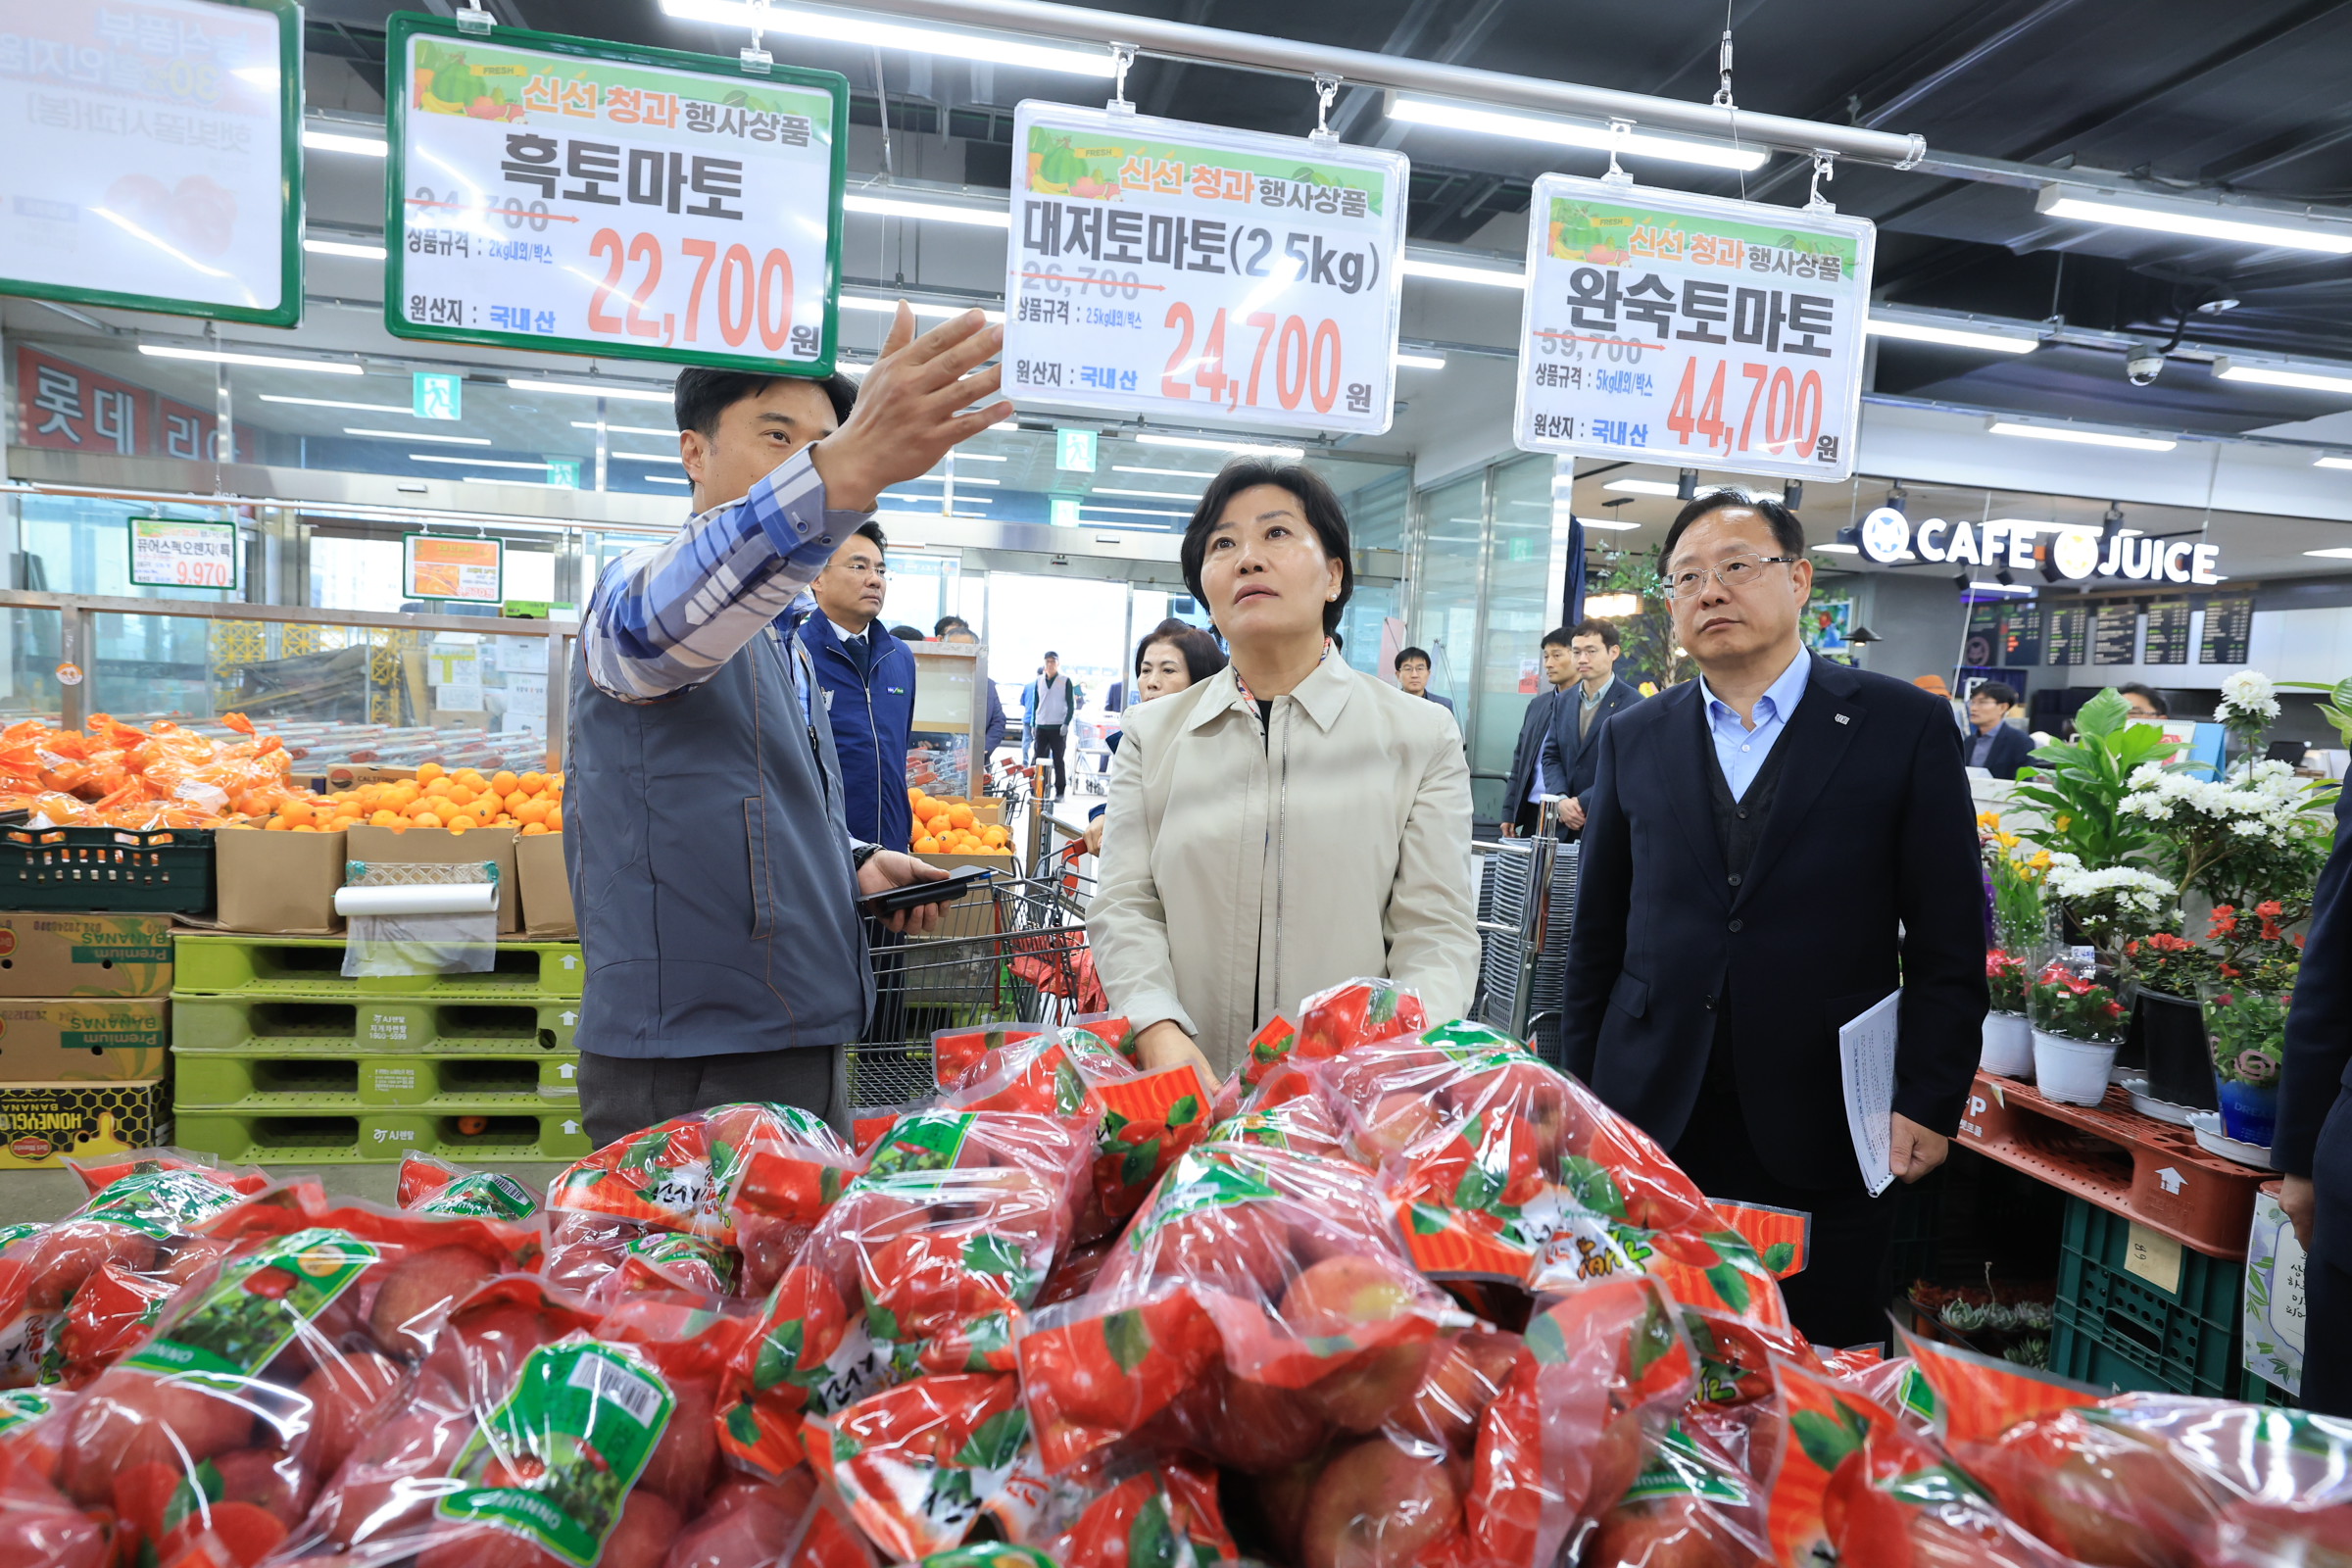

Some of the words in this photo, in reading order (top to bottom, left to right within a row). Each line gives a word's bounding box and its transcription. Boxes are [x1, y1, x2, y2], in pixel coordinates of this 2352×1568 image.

[482, 66, 514, 75] FRESH
[521, 74, 597, 119] 신선
[605, 86, 679, 128] 청과
[685, 101, 810, 147] 행사상품
[1085, 148, 1112, 157] FRESH
[501, 132, 744, 221] 흑토마토
[1118, 155, 1183, 196] 신선
[1191, 165, 1255, 204] 청과
[1259, 177, 1368, 219] 행사상품
[1599, 217, 1623, 226] FRESH
[407, 229, 468, 259] 상품규격
[1628, 225, 1684, 262] 신선
[1690, 233, 1744, 270] 청과
[1748, 245, 1841, 282] 행사상품
[588, 227, 794, 352] 22,700
[790, 324, 820, 358] 원
[410, 295, 463, 326] 원산지
[489, 304, 556, 334] 국내산
[1017, 296, 1069, 325] 상품규격
[1567, 267, 1834, 358] 완숙토마토
[1161, 301, 1342, 414] 24,700
[1346, 383, 1372, 414] 원
[1016, 359, 1061, 387] 원산지
[1080, 366, 1138, 392] 국내산
[1535, 363, 1582, 390] 상품규격
[1595, 369, 1653, 398] 5kg내외/박스
[1667, 356, 1823, 459] 44,700
[1817, 434, 1838, 464] 원
[1534, 413, 1574, 439] 원산지
[1592, 417, 1648, 448] 국내산
[1917, 517, 2038, 570] CAFE
[2097, 534, 2221, 586] JUICE
[81, 932, 167, 945] BANANAS
[94, 949, 167, 960] Premium
[70, 1016, 156, 1030] BANANAS
[83, 1034, 158, 1046] Premium
[1, 1103, 59, 1112] BANANA
[388, 1130, 415, 1141] AJ렌탈
